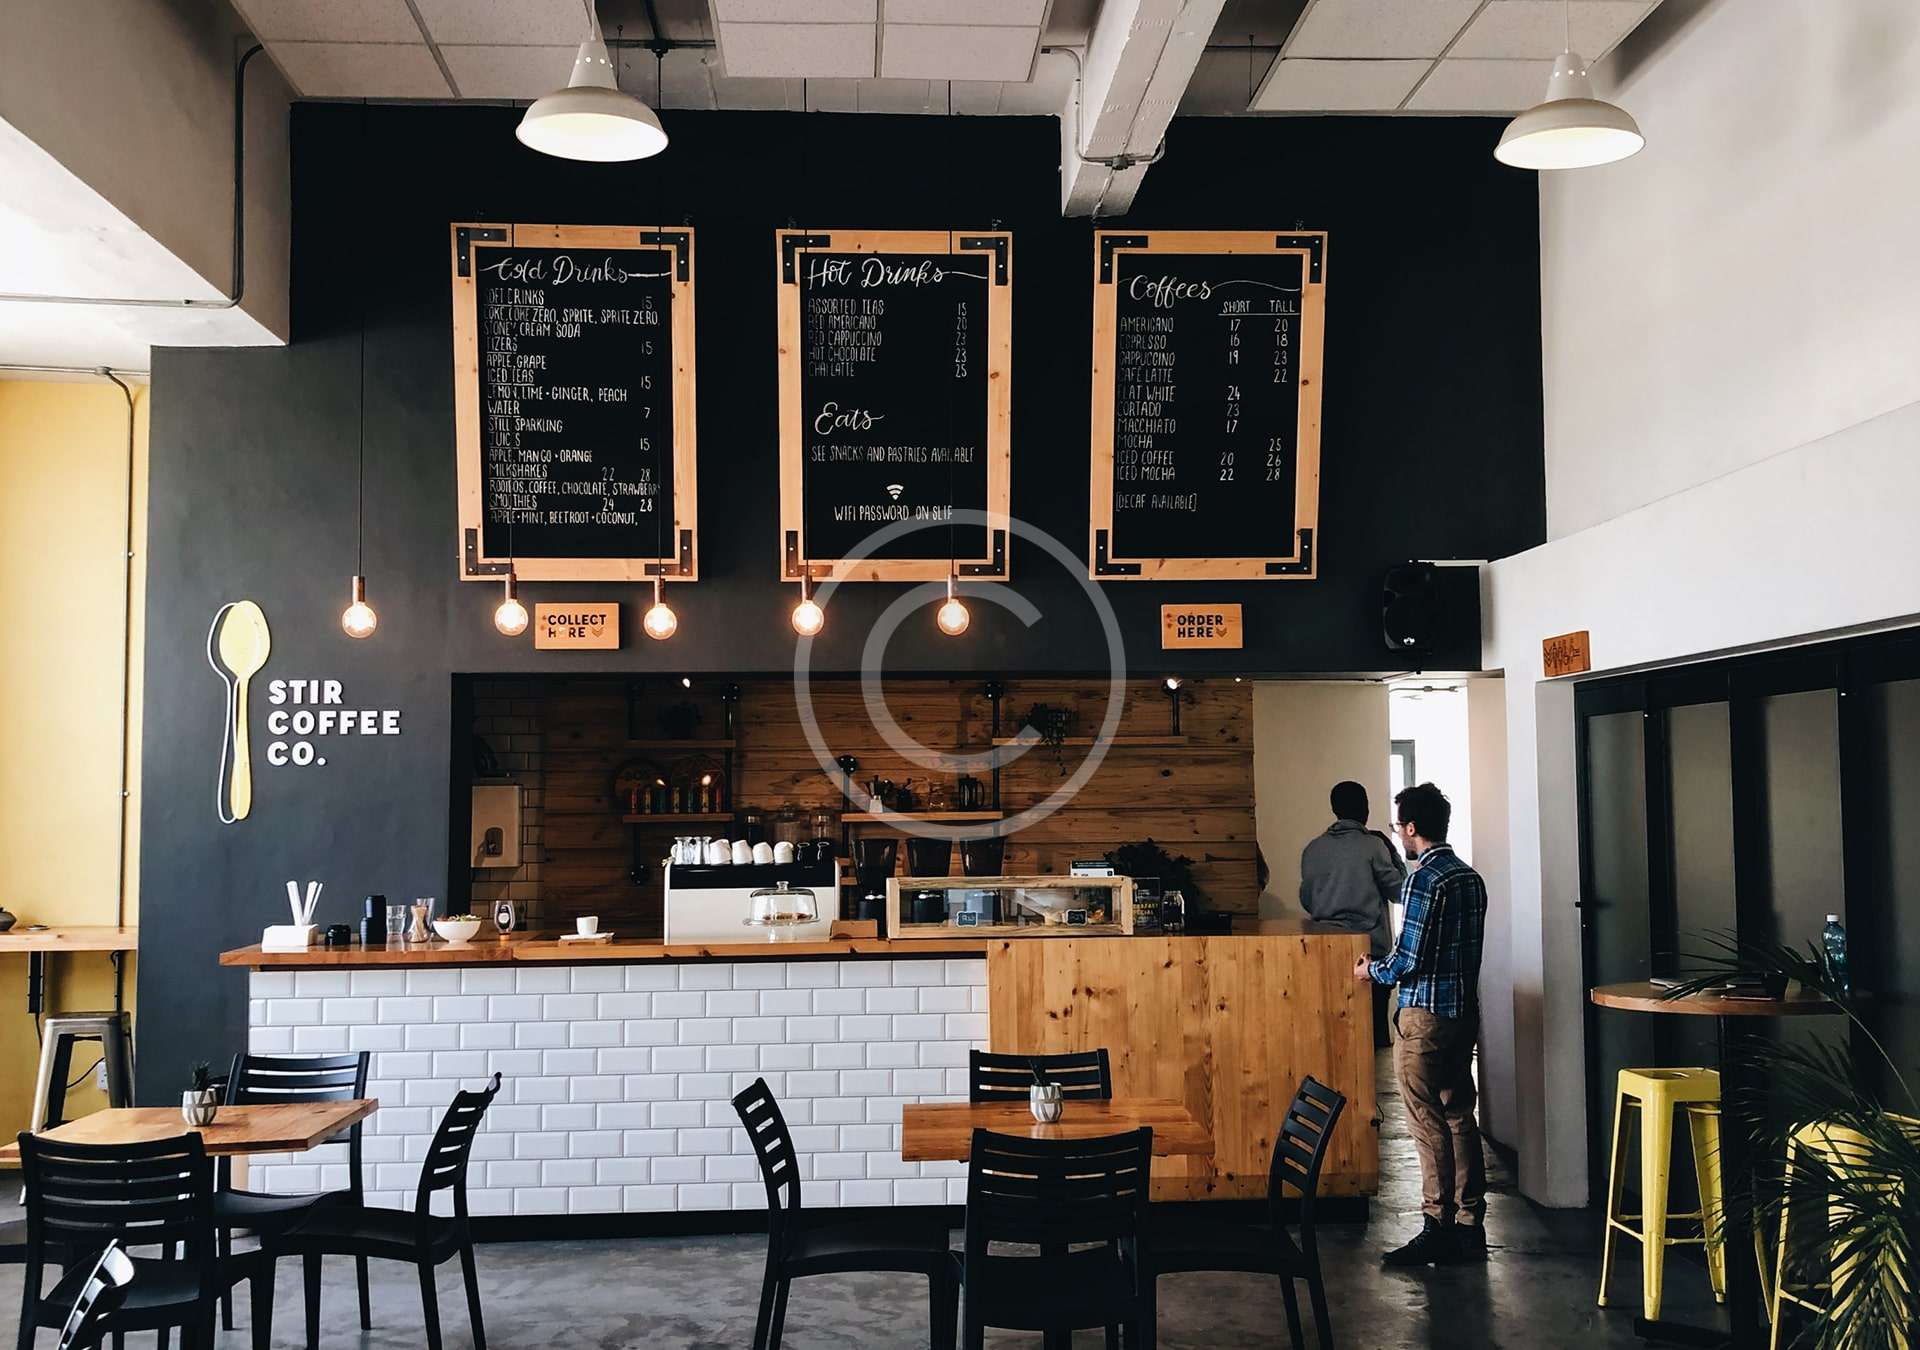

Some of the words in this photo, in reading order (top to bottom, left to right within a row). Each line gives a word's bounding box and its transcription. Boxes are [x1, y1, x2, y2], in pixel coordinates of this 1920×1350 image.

[490, 256, 548, 282] Cold
[552, 255, 632, 286] Drinks
[805, 257, 853, 290] Hot
[860, 256, 947, 289] Drinks
[485, 288, 506, 304] OFT
[1129, 274, 1212, 310] Coffees
[862, 298, 885, 315] TEAS
[956, 301, 968, 317] 15
[1222, 301, 1251, 315] SHORT
[1268, 299, 1295, 314] TALL
[600, 309, 631, 326] SPRITE
[827, 314, 877, 330] AMERICANO
[1119, 316, 1175, 333] AMERICANO
[1229, 318, 1242, 333] 17
[1273, 318, 1289, 333] 20
[519, 321, 551, 337] CREAM
[555, 322, 582, 339] SODA
[827, 330, 882, 346] CAPPUCCINO
[641, 341, 653, 355] 15
[1229, 334, 1241, 348] 16
[1275, 333, 1289, 348] 18
[516, 354, 547, 370] GRAPE
[827, 346, 877, 362] CHOCOLATE
[1228, 350, 1240, 366] 19
[1273, 350, 1288, 366] 23
[955, 363, 968, 378] 25
[1144, 367, 1174, 384] LATTE
[1273, 369, 1288, 384] 22
[640, 375, 651, 390] 15
[598, 387, 628, 402] PEACH
[1118, 384, 1143, 401] LAT
[1145, 385, 1177, 402] WHITE
[1226, 385, 1241, 401] 24
[488, 400, 520, 415] WATER
[643, 407, 651, 419] 7
[814, 401, 879, 435] Eats
[1226, 402, 1241, 417] 23
[514, 417, 563, 433] SPARKLING
[1117, 417, 1177, 434] MACCHIATO
[1226, 418, 1239, 434] 17
[489, 432, 521, 447] JUICS
[640, 438, 650, 451] 15
[1116, 433, 1154, 449] MOCHA
[1269, 437, 1283, 452] 25
[811, 445, 827, 463] SEE
[829, 445, 865, 463] SNACKS
[867, 446, 886, 463] AND
[887, 446, 927, 463] PASTRIES
[930, 446, 976, 463] AVAIABLE
[1116, 449, 1138, 465] ICED
[1219, 451, 1235, 467] 20
[1266, 452, 1283, 468] 26
[488, 463, 548, 478] MILKSHAKES
[601, 466, 615, 482] 22
[640, 467, 651, 483] 28
[1116, 465, 1138, 481] ICED
[1140, 466, 1176, 481] MOCHA
[1219, 467, 1235, 481] 22
[1265, 467, 1282, 482] 28
[612, 482, 661, 497] STRAWBERR
[640, 497, 653, 513] 28
[833, 504, 857, 521] WIFI
[859, 504, 910, 521] PASSWORD
[914, 504, 930, 521] ON
[548, 614, 607, 626] COLLECT
[1177, 614, 1224, 626] ORDER
[548, 626, 576, 638] HRE
[1177, 627, 1214, 638] HERE
[268, 679, 344, 705] STIR
[267, 710, 401, 736] COFFEE
[266, 741, 327, 767] CO.
